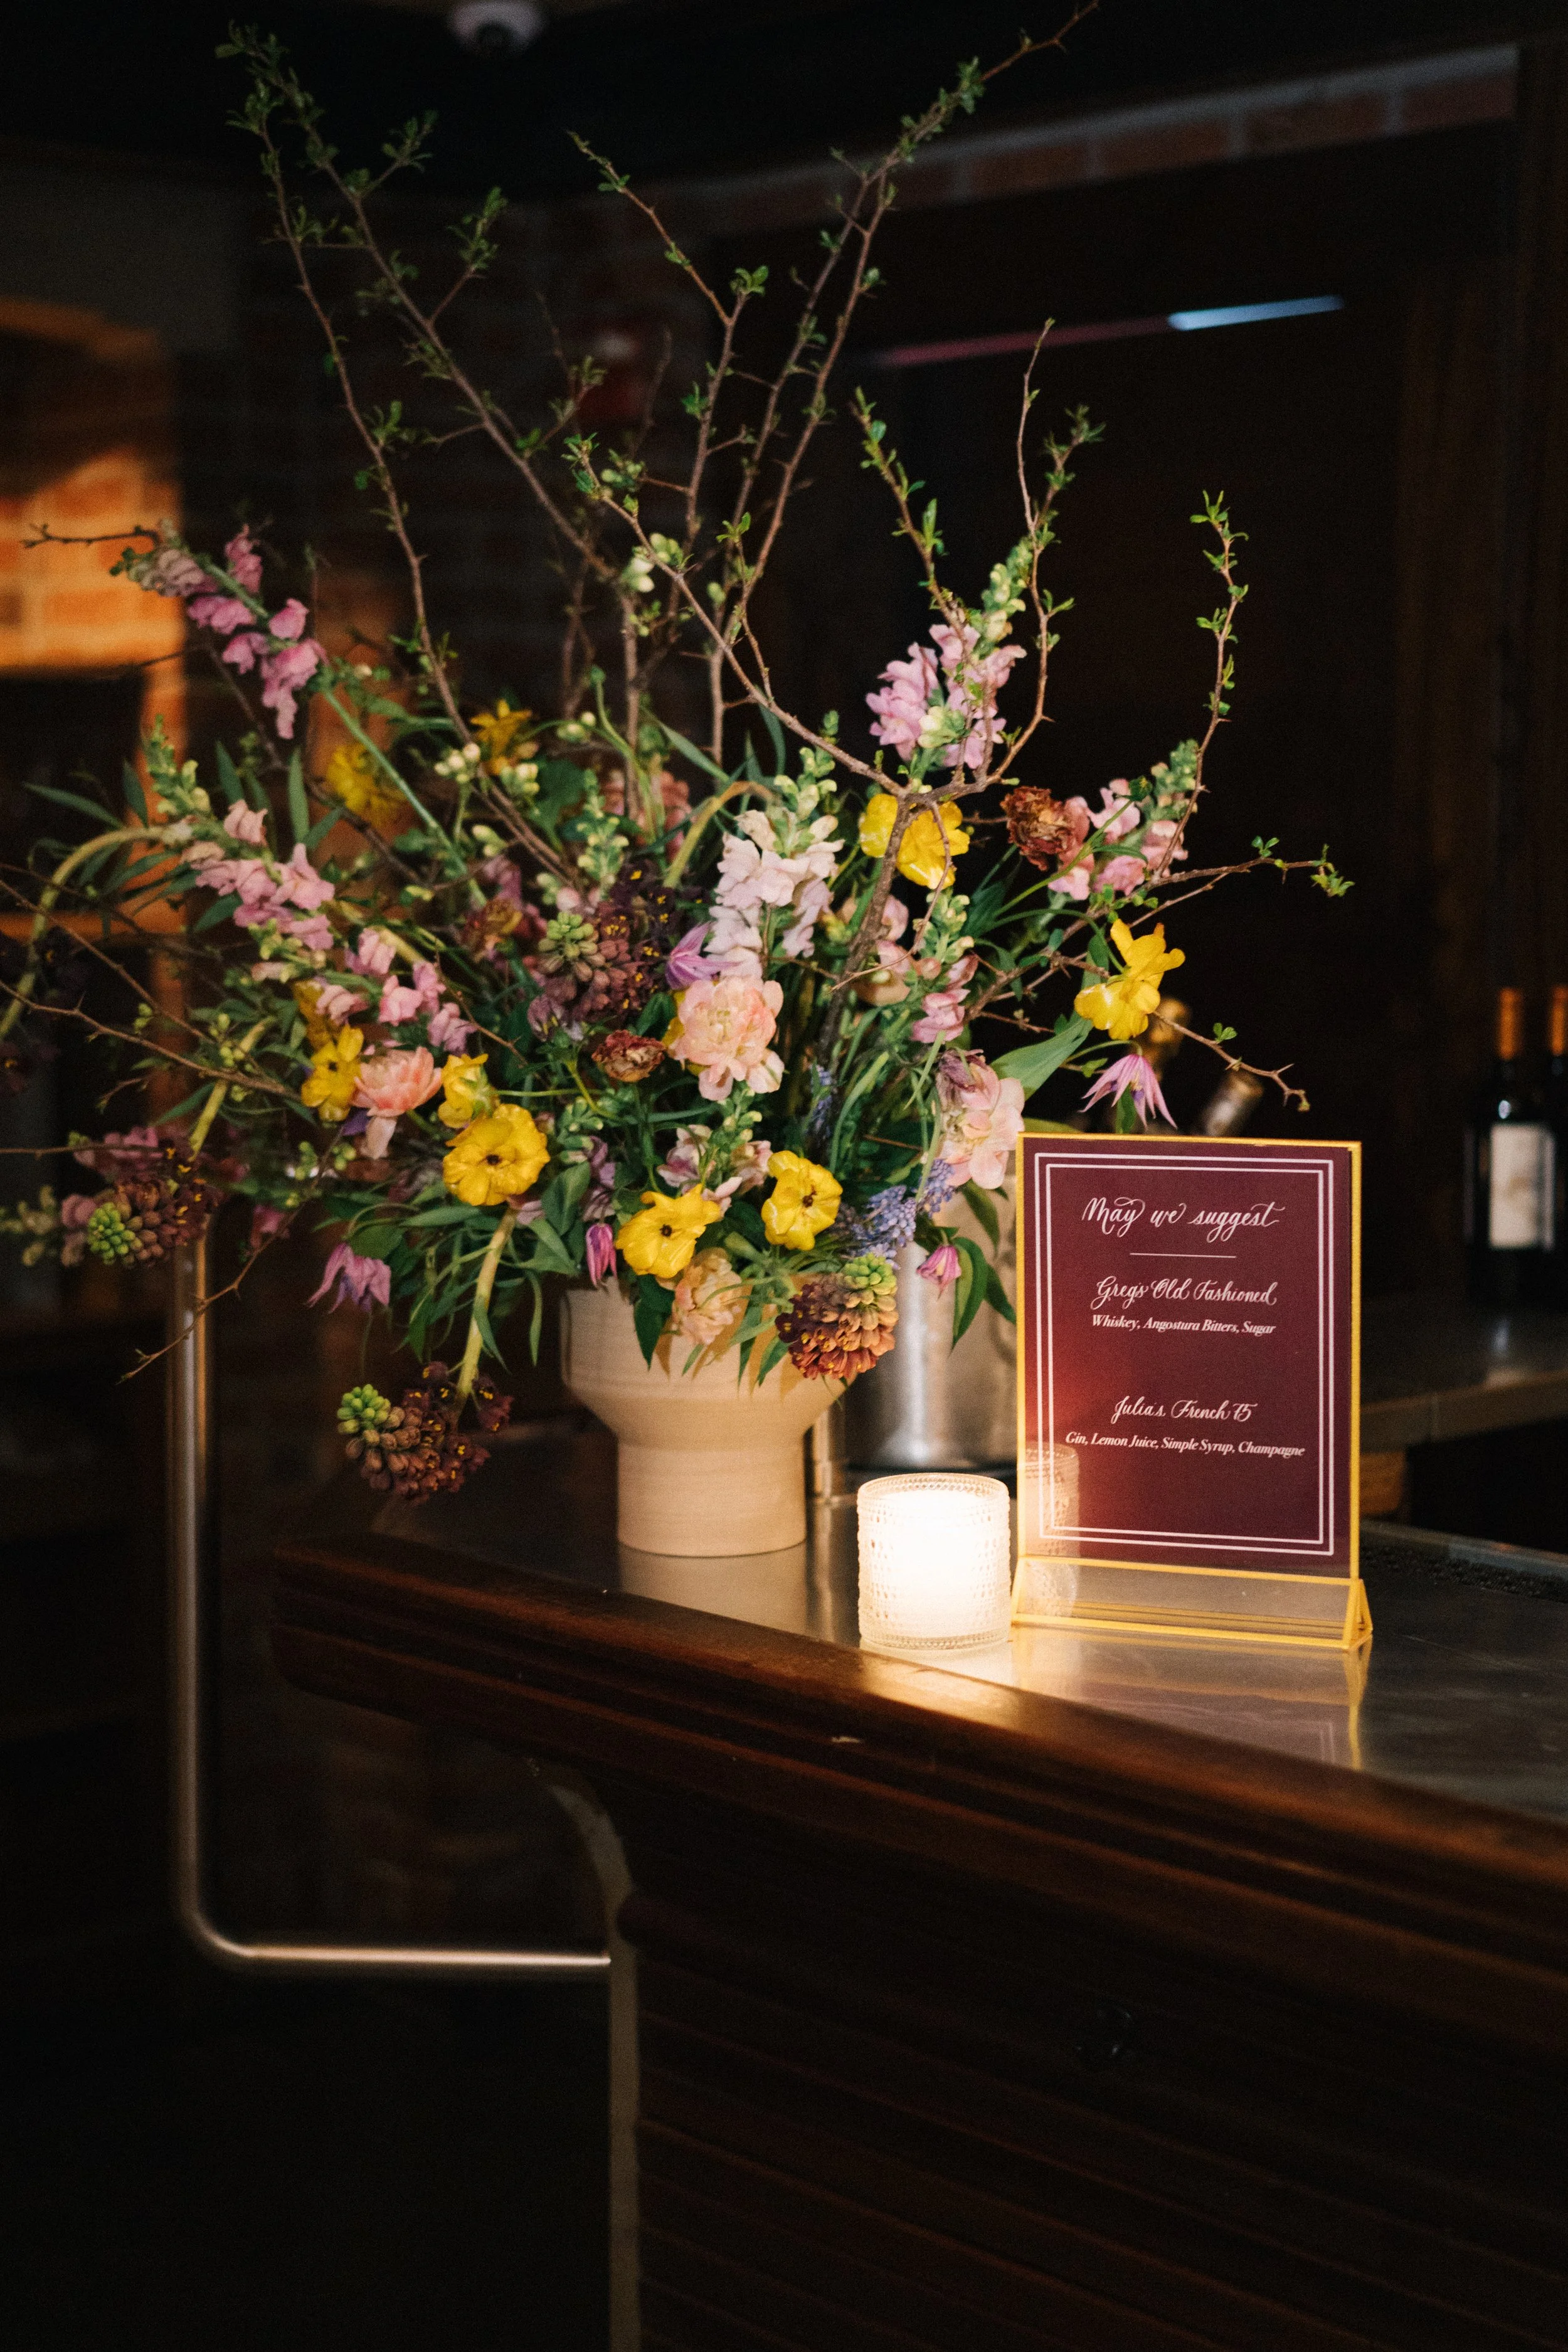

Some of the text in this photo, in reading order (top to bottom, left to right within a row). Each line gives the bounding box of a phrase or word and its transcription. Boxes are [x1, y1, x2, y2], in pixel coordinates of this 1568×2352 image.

[1082, 1197, 1286, 1243] May we suggest
[1151, 1278, 1193, 1300] Old
[1193, 1279, 1278, 1306] Fashioned
[1092, 1314, 1276, 1336] Whiskey, Angostura Bitters, Sugar
[1170, 1400, 1231, 1420] French
[1232, 1403, 1258, 1422] 75
[1066, 1431, 1088, 1446] Gin,
[1091, 1433, 1128, 1446] Lemon
[1128, 1434, 1159, 1449] Juice,
[1160, 1436, 1199, 1453] Simple
[1238, 1441, 1305, 1459] Champagne
